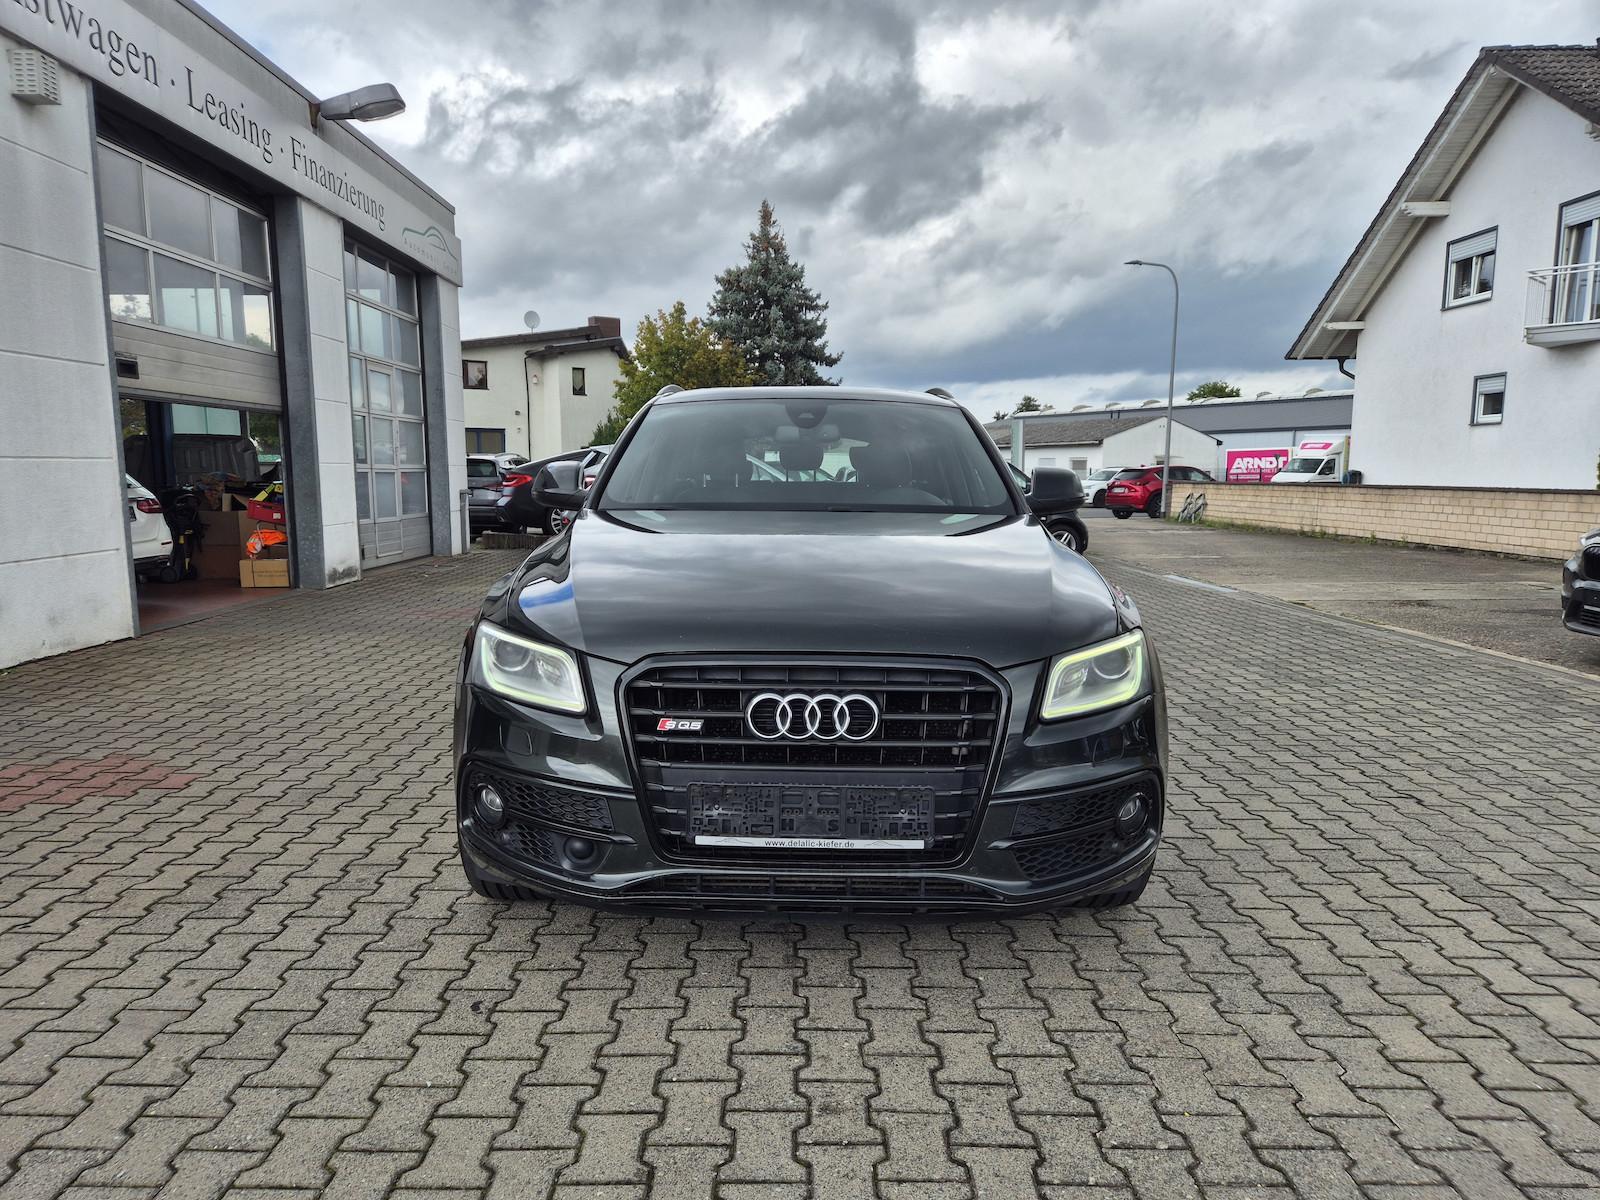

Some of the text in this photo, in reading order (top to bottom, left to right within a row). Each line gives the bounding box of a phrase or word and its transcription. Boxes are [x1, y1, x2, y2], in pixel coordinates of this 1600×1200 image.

[184, 65, 274, 164] Leasing
[289, 135, 386, 232] Finanzierung
[1229, 456, 1287, 473] ARNDT
[661, 719, 702, 730] SQ5
[764, 839, 855, 849] www.delalic-kiefer.de
